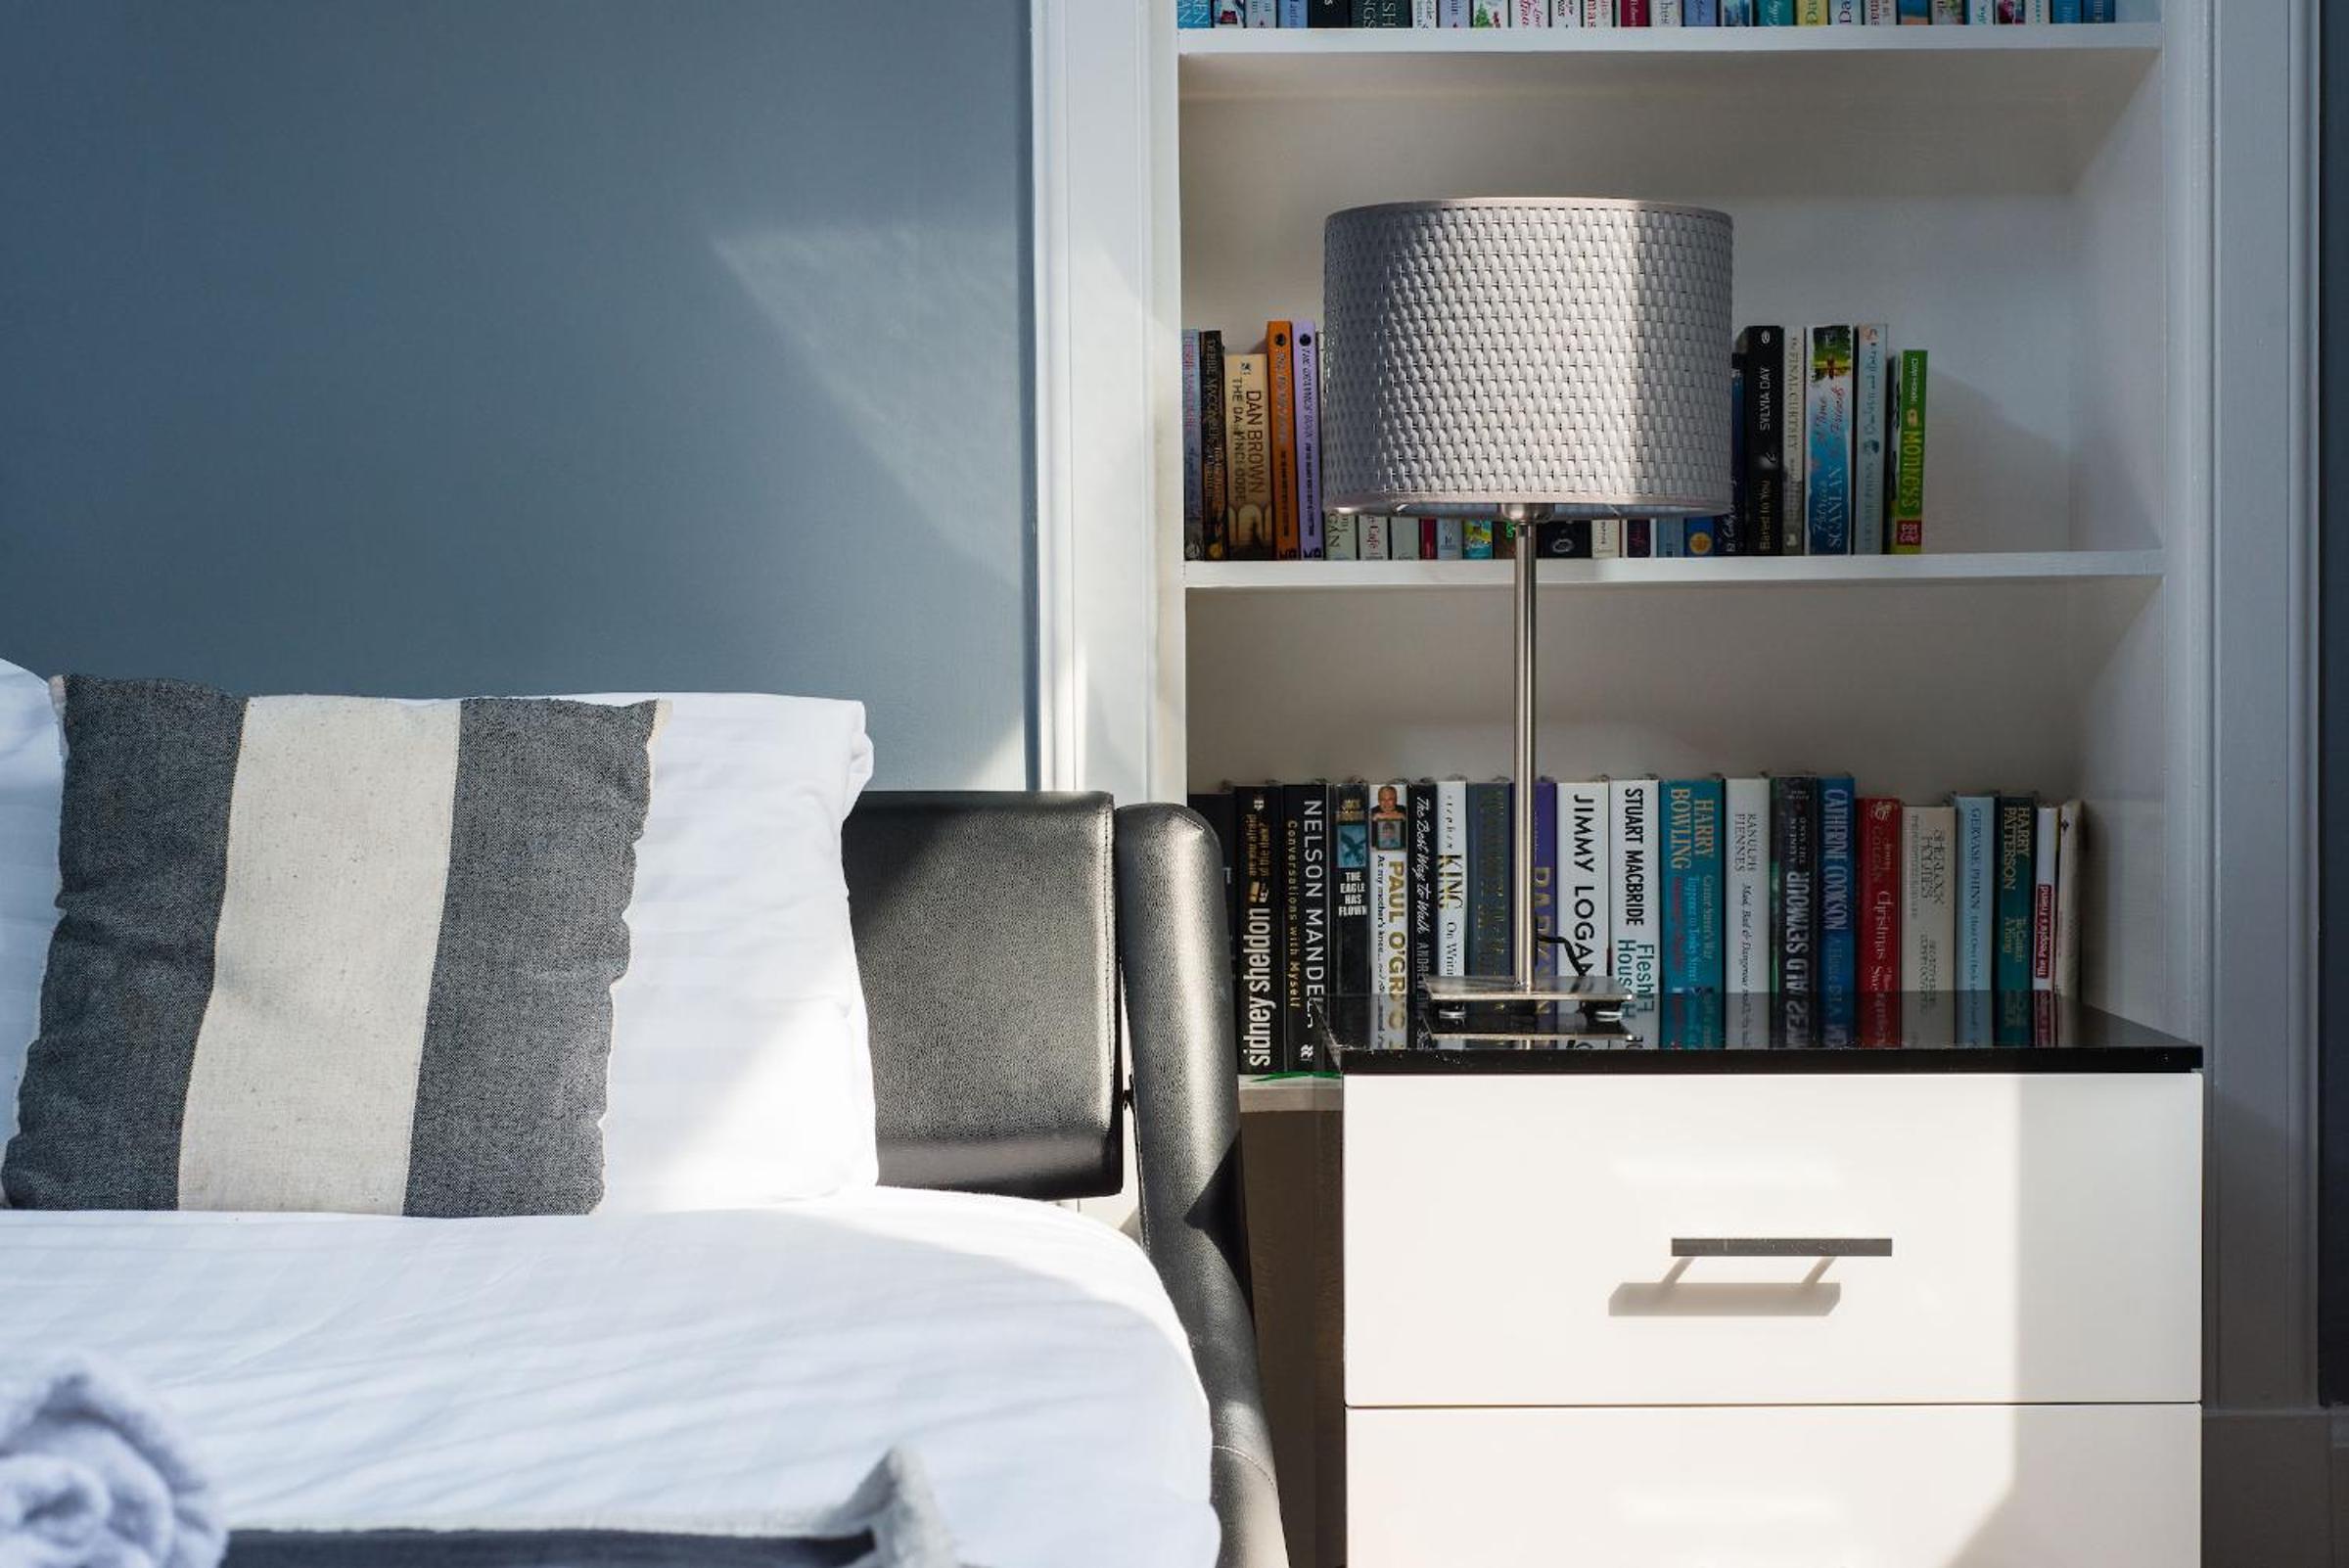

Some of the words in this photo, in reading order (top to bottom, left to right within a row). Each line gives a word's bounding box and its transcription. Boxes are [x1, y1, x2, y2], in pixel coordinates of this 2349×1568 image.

[1232, 378, 1243, 401] THE
[1760, 367, 1771, 388] DAY
[1788, 351, 1799, 390] FINAL
[1233, 406, 1243, 424] DA
[1246, 391, 1263, 426] DAN
[1760, 392, 1771, 431] SYLVIA
[1248, 431, 1265, 493] BROWN
[1234, 468, 1246, 502] CODE
[1826, 465, 1842, 548] SCANLAN
[1416, 796, 1429, 818] The
[1447, 794, 1456, 849] stephen
[1625, 788, 1644, 844] STUART
[1824, 788, 1849, 859] CATHERINE
[1246, 814, 1257, 843] afraid
[1304, 800, 1323, 898] NELSON
[1416, 819, 1430, 852] Best
[1574, 793, 1594, 873] JIMMY
[1670, 788, 1691, 870] BOWLING
[1694, 799, 1715, 858] HARRY
[1734, 813, 1746, 872] FIENNES
[1747, 813, 1758, 872] RANULPH
[1969, 807, 1982, 864] GERVASE
[2004, 805, 2016, 891] PATTERSON
[2016, 805, 2030, 857] HARRY
[1248, 843, 1259, 860] you
[1248, 861, 1257, 877] are
[1259, 850, 1269, 866] the
[1287, 820, 1298, 925] Conversations
[1377, 854, 1386, 867] At
[1412, 853, 1429, 881] Way
[1920, 836, 1933, 899] HOLMES
[1932, 829, 1946, 905] SHERLOCK
[1340, 883, 1365, 894] EAGLE
[1344, 871, 1361, 882] THE
[1375, 869, 1385, 884] my
[1388, 860, 1405, 923] PAUL
[1416, 882, 1431, 898] to
[1437, 853, 1463, 909] KING
[1625, 850, 1644, 926] MACBRIDE
[1969, 868, 1982, 910] PHINN
[1338, 905, 1367, 917] FLOWN
[1344, 894, 1361, 905] HAS
[1377, 886, 1386, 928] mother's
[1416, 899, 1430, 934] Walk
[1742, 909, 1753, 928] Bad
[1786, 870, 1811, 954] SEYMOUR
[1824, 865, 1849, 931] COOKSON
[2037, 886, 2050, 916] Friend
[1288, 926, 1300, 956] with
[1446, 921, 1456, 938] On
[1873, 890, 1895, 960] Christmas
[2037, 917, 2050, 958] People's
[1244, 908, 1271, 992] sheldon
[1388, 931, 1405, 995] O'GR
[1635, 944, 1654, 992] Flesh
[2037, 958, 2048, 976] The
[1288, 961, 1302, 1008] Myself
[1244, 993, 1275, 1067] sidney
